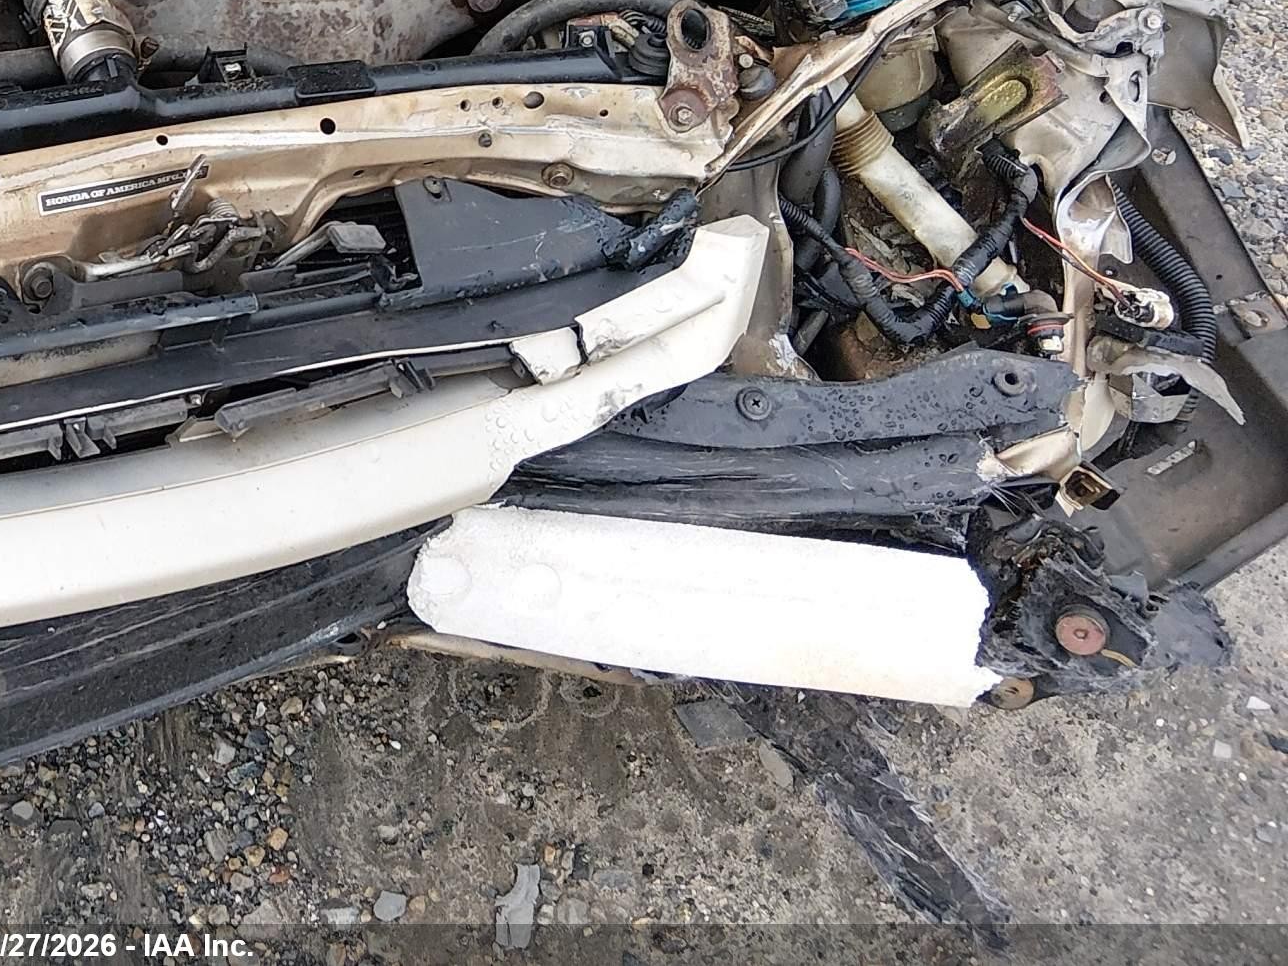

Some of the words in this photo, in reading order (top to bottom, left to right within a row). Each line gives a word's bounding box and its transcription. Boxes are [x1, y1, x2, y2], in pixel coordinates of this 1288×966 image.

[45, 192, 90, 207] HONDA
[90, 189, 106, 201] OF
[105, 179, 157, 196] AMERICA
